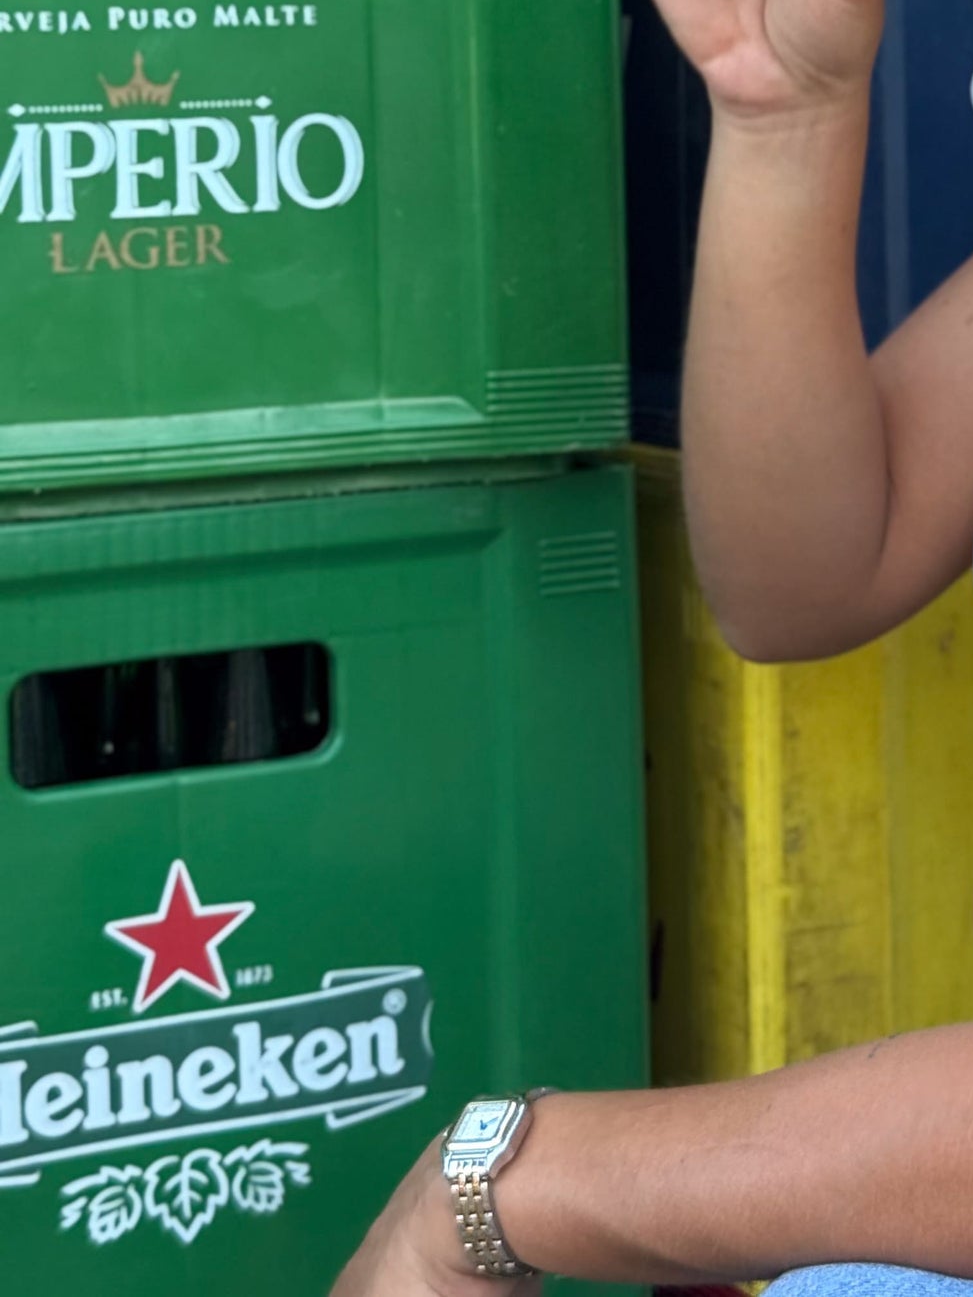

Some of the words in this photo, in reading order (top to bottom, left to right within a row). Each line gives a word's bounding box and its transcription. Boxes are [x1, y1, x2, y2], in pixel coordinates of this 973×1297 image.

[107, 5, 198, 31] PURO
[213, 4, 318, 27] MALTE
[49, 225, 231, 274] LAGER
